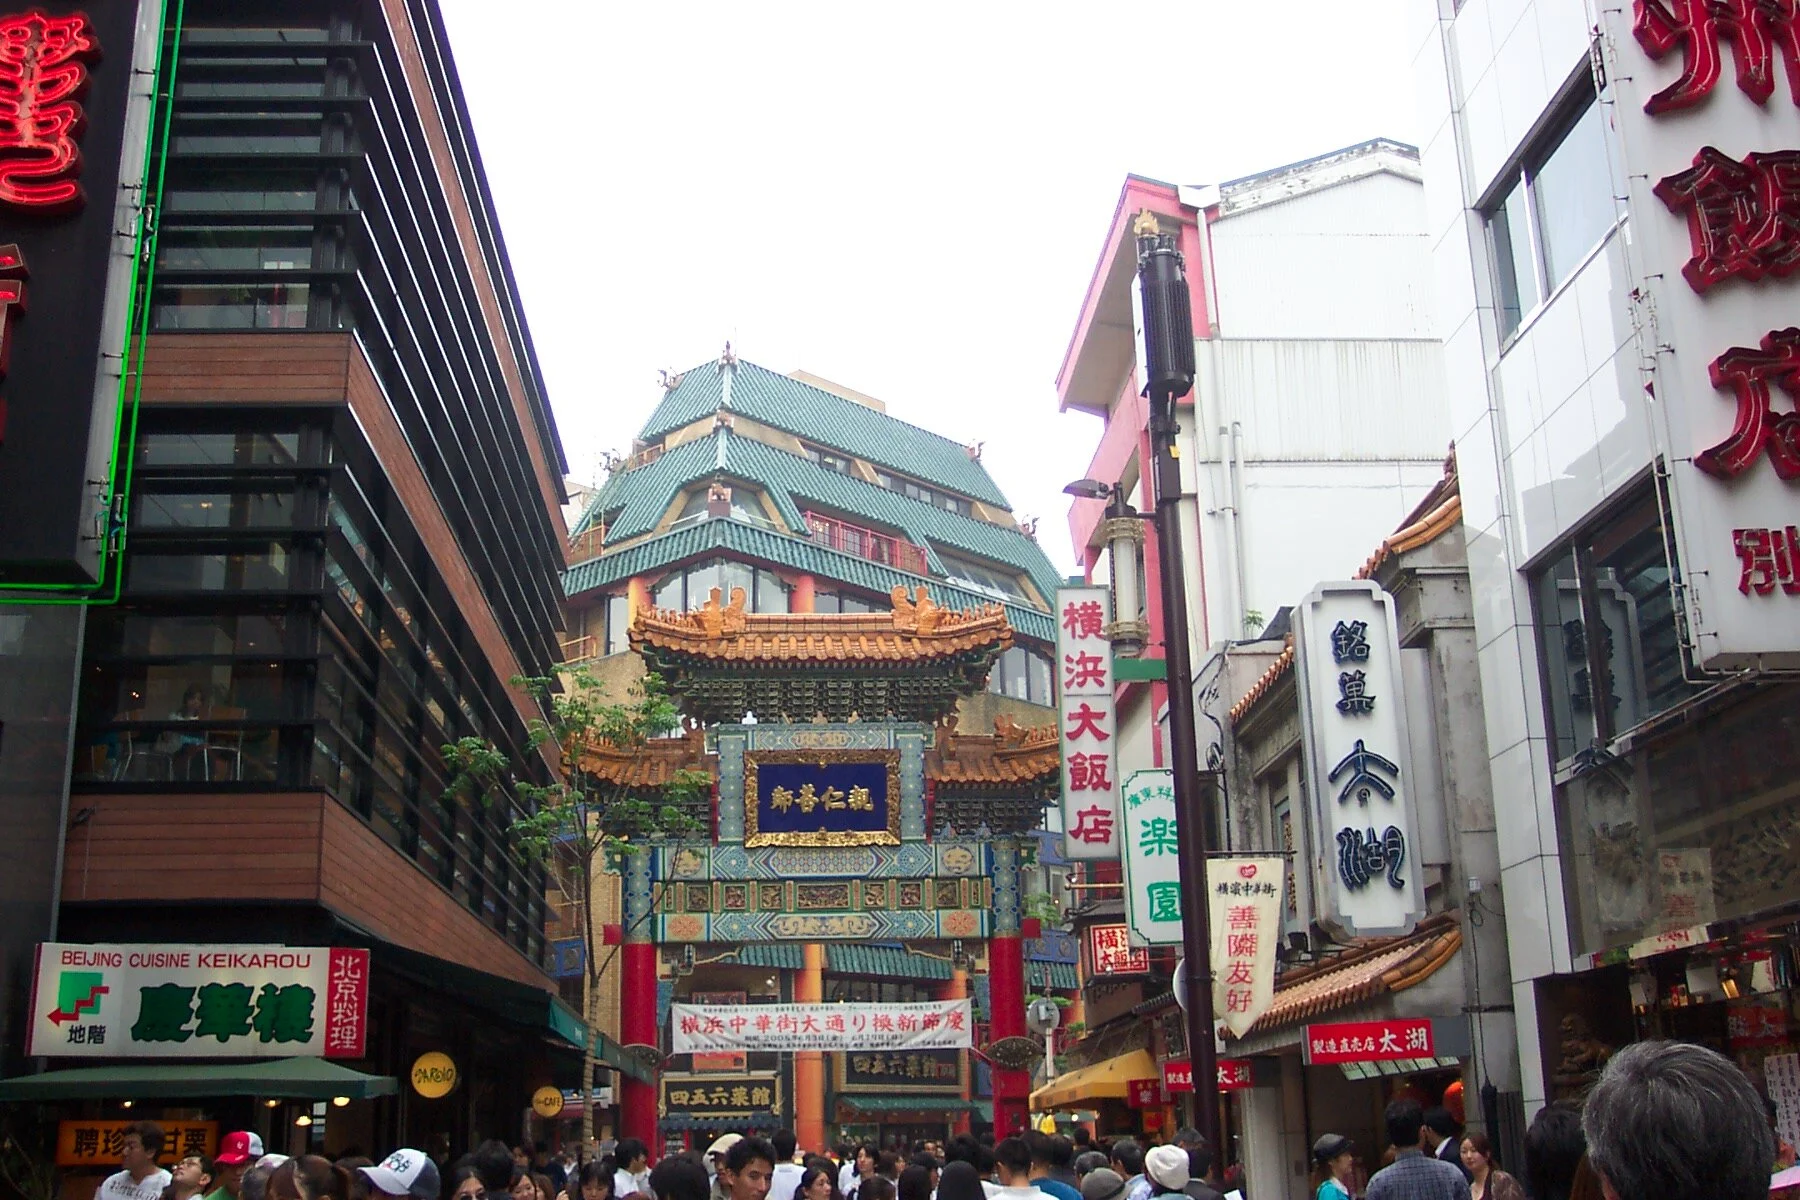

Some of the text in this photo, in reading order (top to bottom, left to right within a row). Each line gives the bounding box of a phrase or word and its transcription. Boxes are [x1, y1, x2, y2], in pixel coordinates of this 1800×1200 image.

[1330, 620, 1377, 717] 銘菓
[1063, 600, 1114, 844] 横浜大飯店
[61, 950, 311, 968] BEIJING CUISINE KEIKAROU
[1226, 905, 1260, 1013] 善隣友好
[330, 955, 361, 1049] 北京料理
[67, 1024, 106, 1045] 地階
[1379, 1027, 1428, 1053] 太湖
[670, 1087, 771, 1106] 四五六菜館
